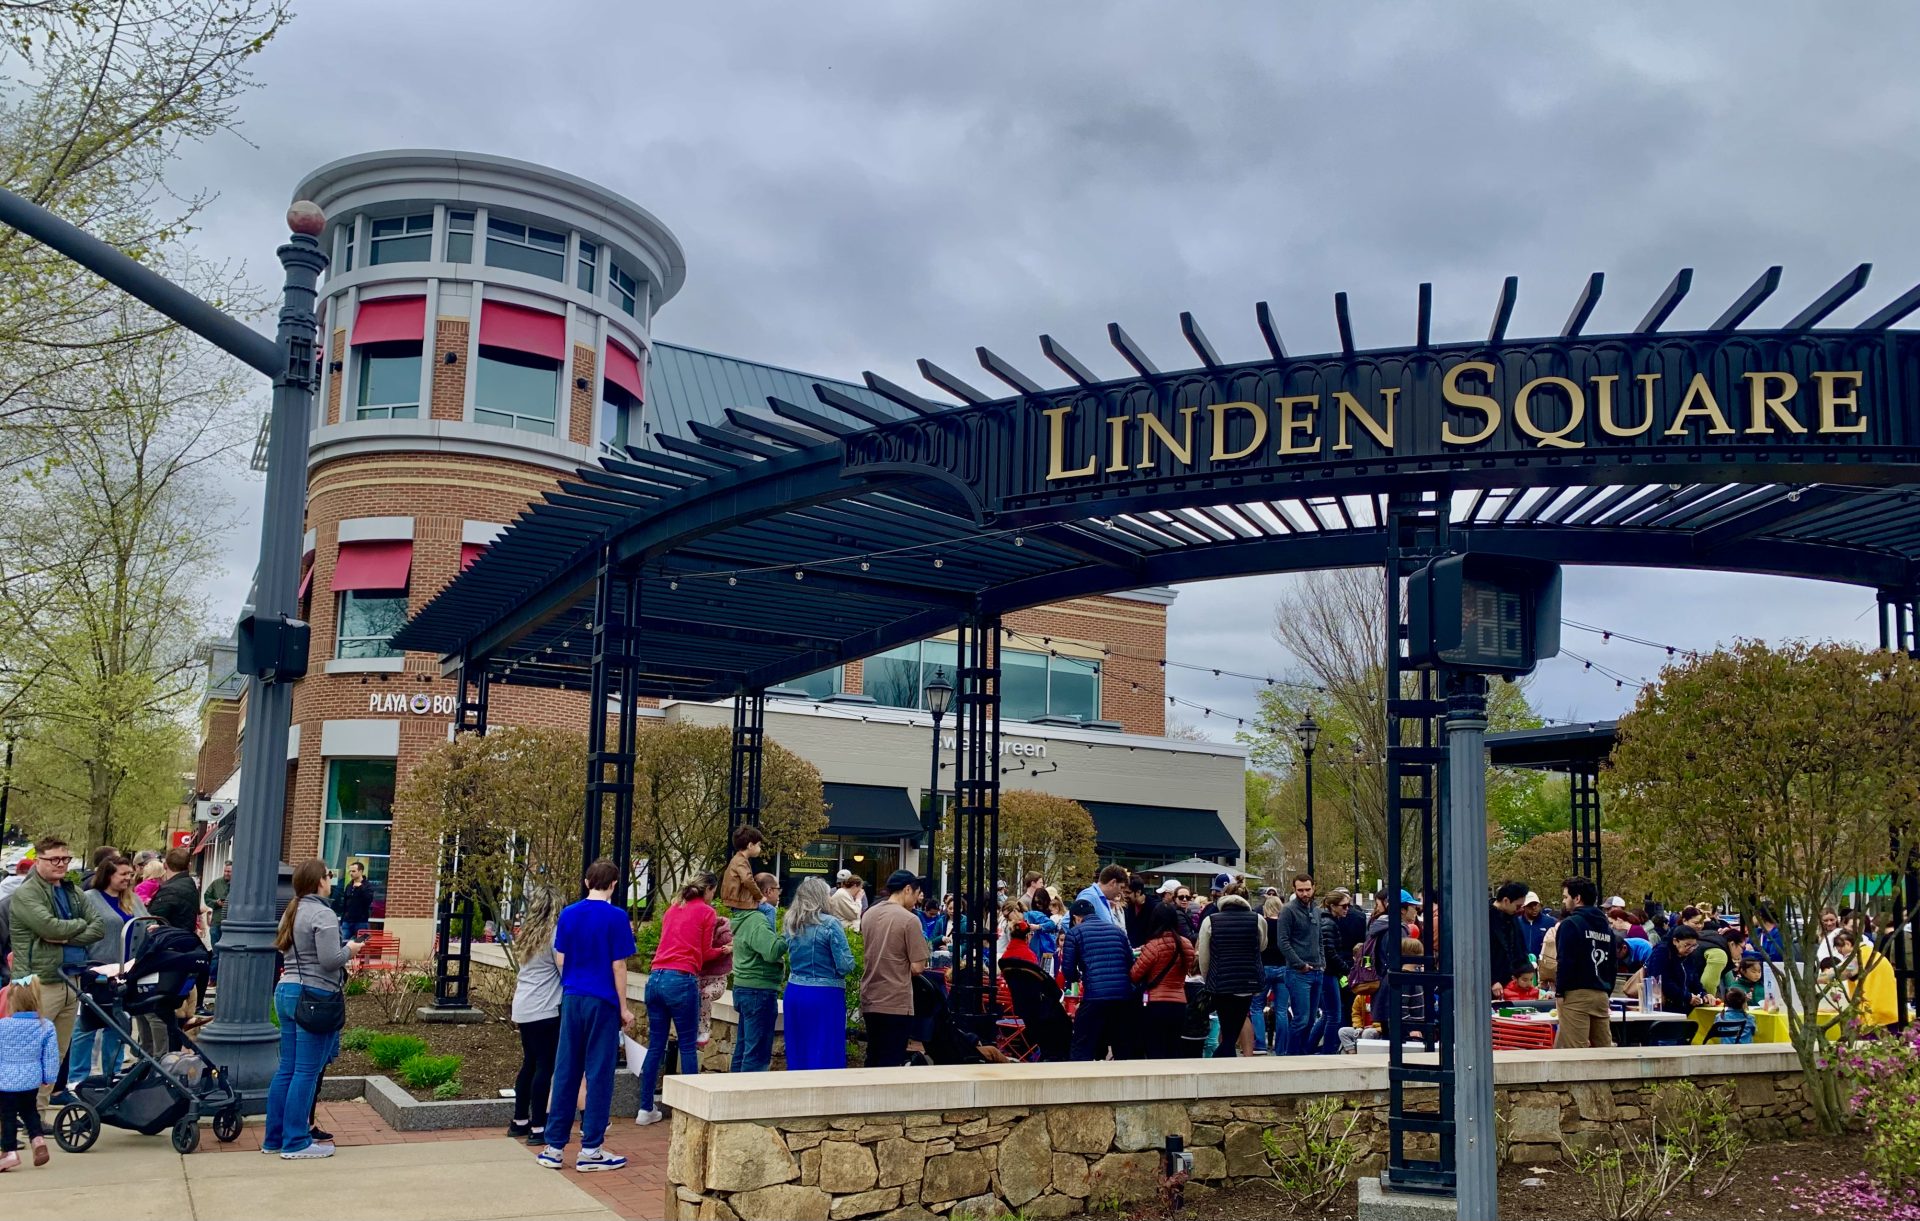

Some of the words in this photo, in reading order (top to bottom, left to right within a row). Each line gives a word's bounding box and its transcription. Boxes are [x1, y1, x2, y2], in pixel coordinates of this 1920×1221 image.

[1042, 387, 1401, 481] LINDEN
[1440, 360, 1869, 449] SQUARE
[369, 693, 408, 713] PLAYA
[433, 695, 478, 716] BOL
[790, 860, 829, 868] SWEETPASS
